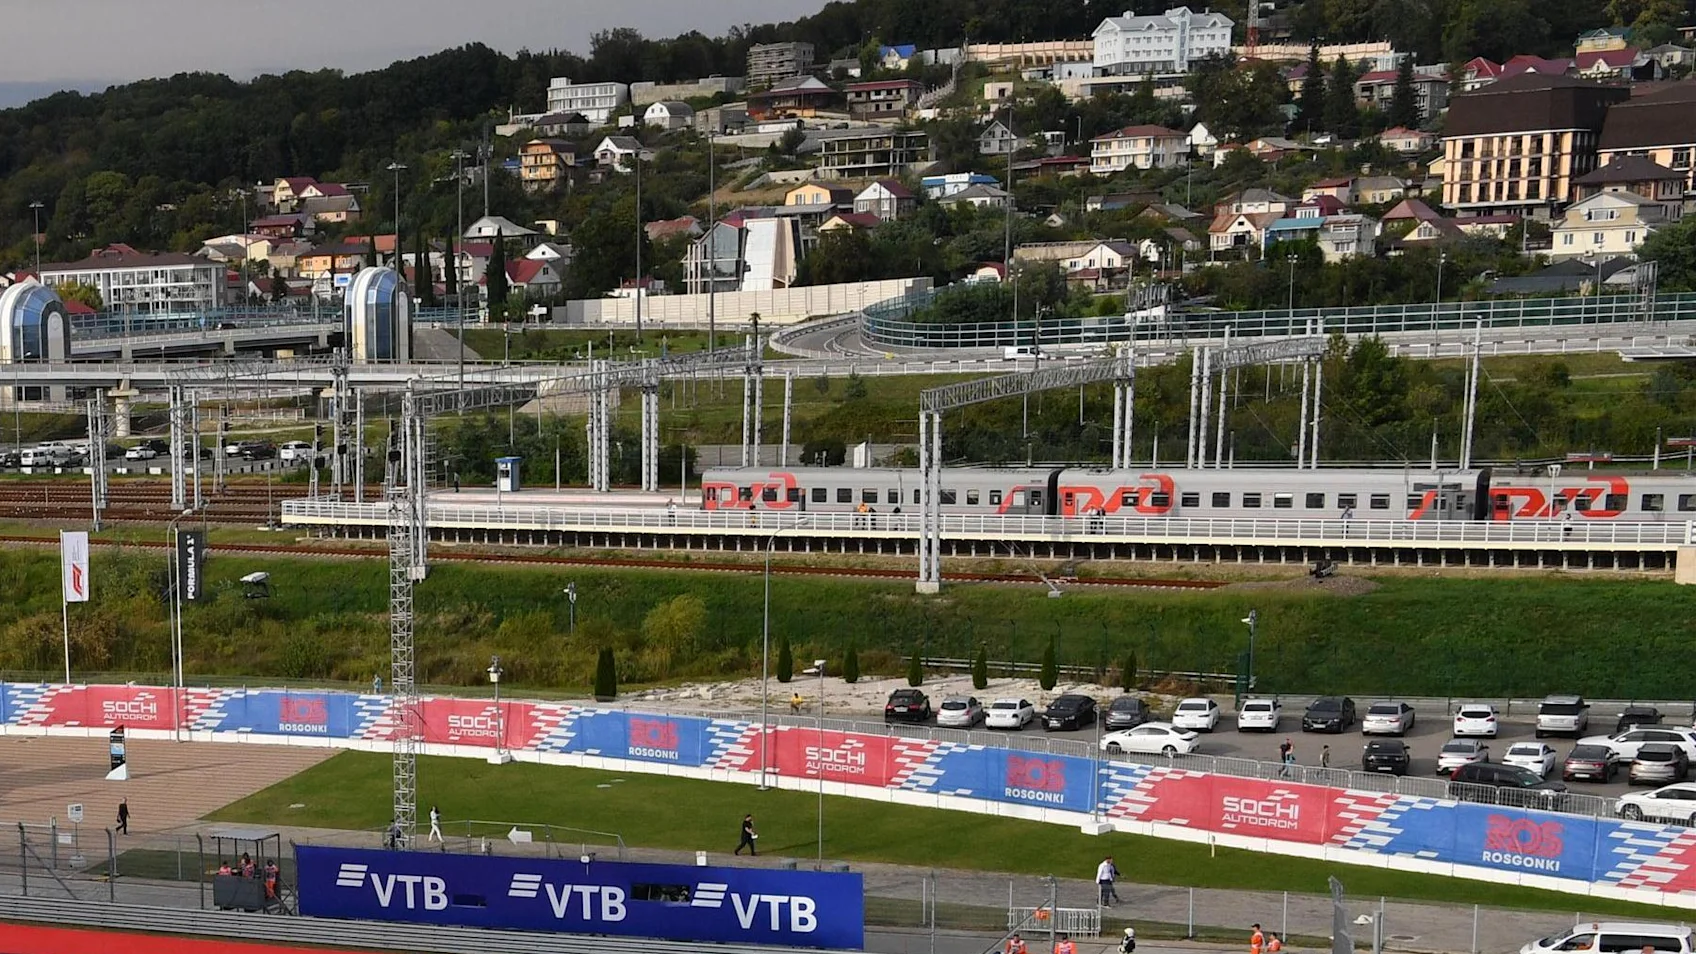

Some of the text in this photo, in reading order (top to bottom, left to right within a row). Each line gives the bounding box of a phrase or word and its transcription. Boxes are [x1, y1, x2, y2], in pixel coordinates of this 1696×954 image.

[187, 546, 196, 600] FORMULA
[103, 701, 157, 714] SOCHI
[103, 713, 157, 721] AUTODROM
[448, 715, 503, 730] SOCHI
[279, 723, 327, 733] ROSGONKI
[629, 747, 679, 760] ROSGONKI
[805, 747, 866, 766] SOCHI
[805, 760, 865, 775] AUTODROM
[1005, 787, 1064, 804] ROSGONKI
[1222, 796, 1300, 819] SOCHI
[1222, 812, 1298, 830] AUTODROM
[1482, 850, 1561, 873] ROSGONKI
[370, 872, 448, 911] VTB
[545, 883, 627, 922] VTB
[730, 892, 818, 933] VTB
